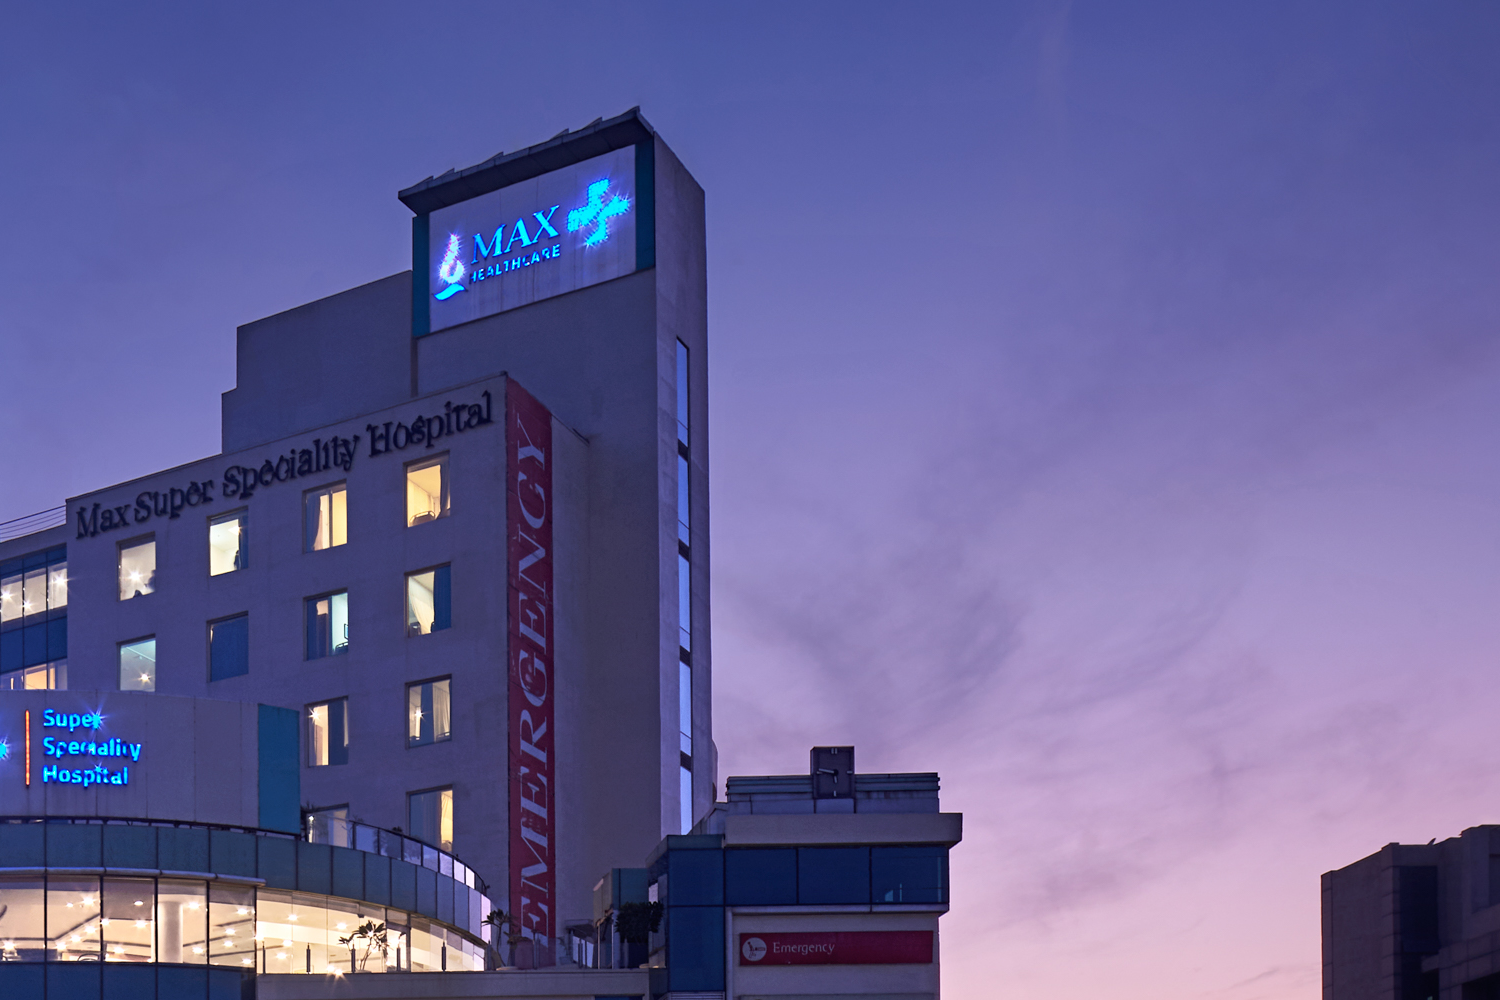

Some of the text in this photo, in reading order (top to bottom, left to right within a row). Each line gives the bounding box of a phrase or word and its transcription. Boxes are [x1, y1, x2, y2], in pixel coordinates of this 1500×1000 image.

[471, 204, 560, 264] MAX
[469, 244, 561, 285] HEALTHCARE
[75, 391, 494, 539] Max Super Speciality Hospital
[517, 413, 550, 948] EMERGENCY
[43, 708, 101, 732] Super
[42, 736, 141, 761] Speciality
[43, 764, 128, 787] Hospital
[772, 941, 835, 955] Emergency
